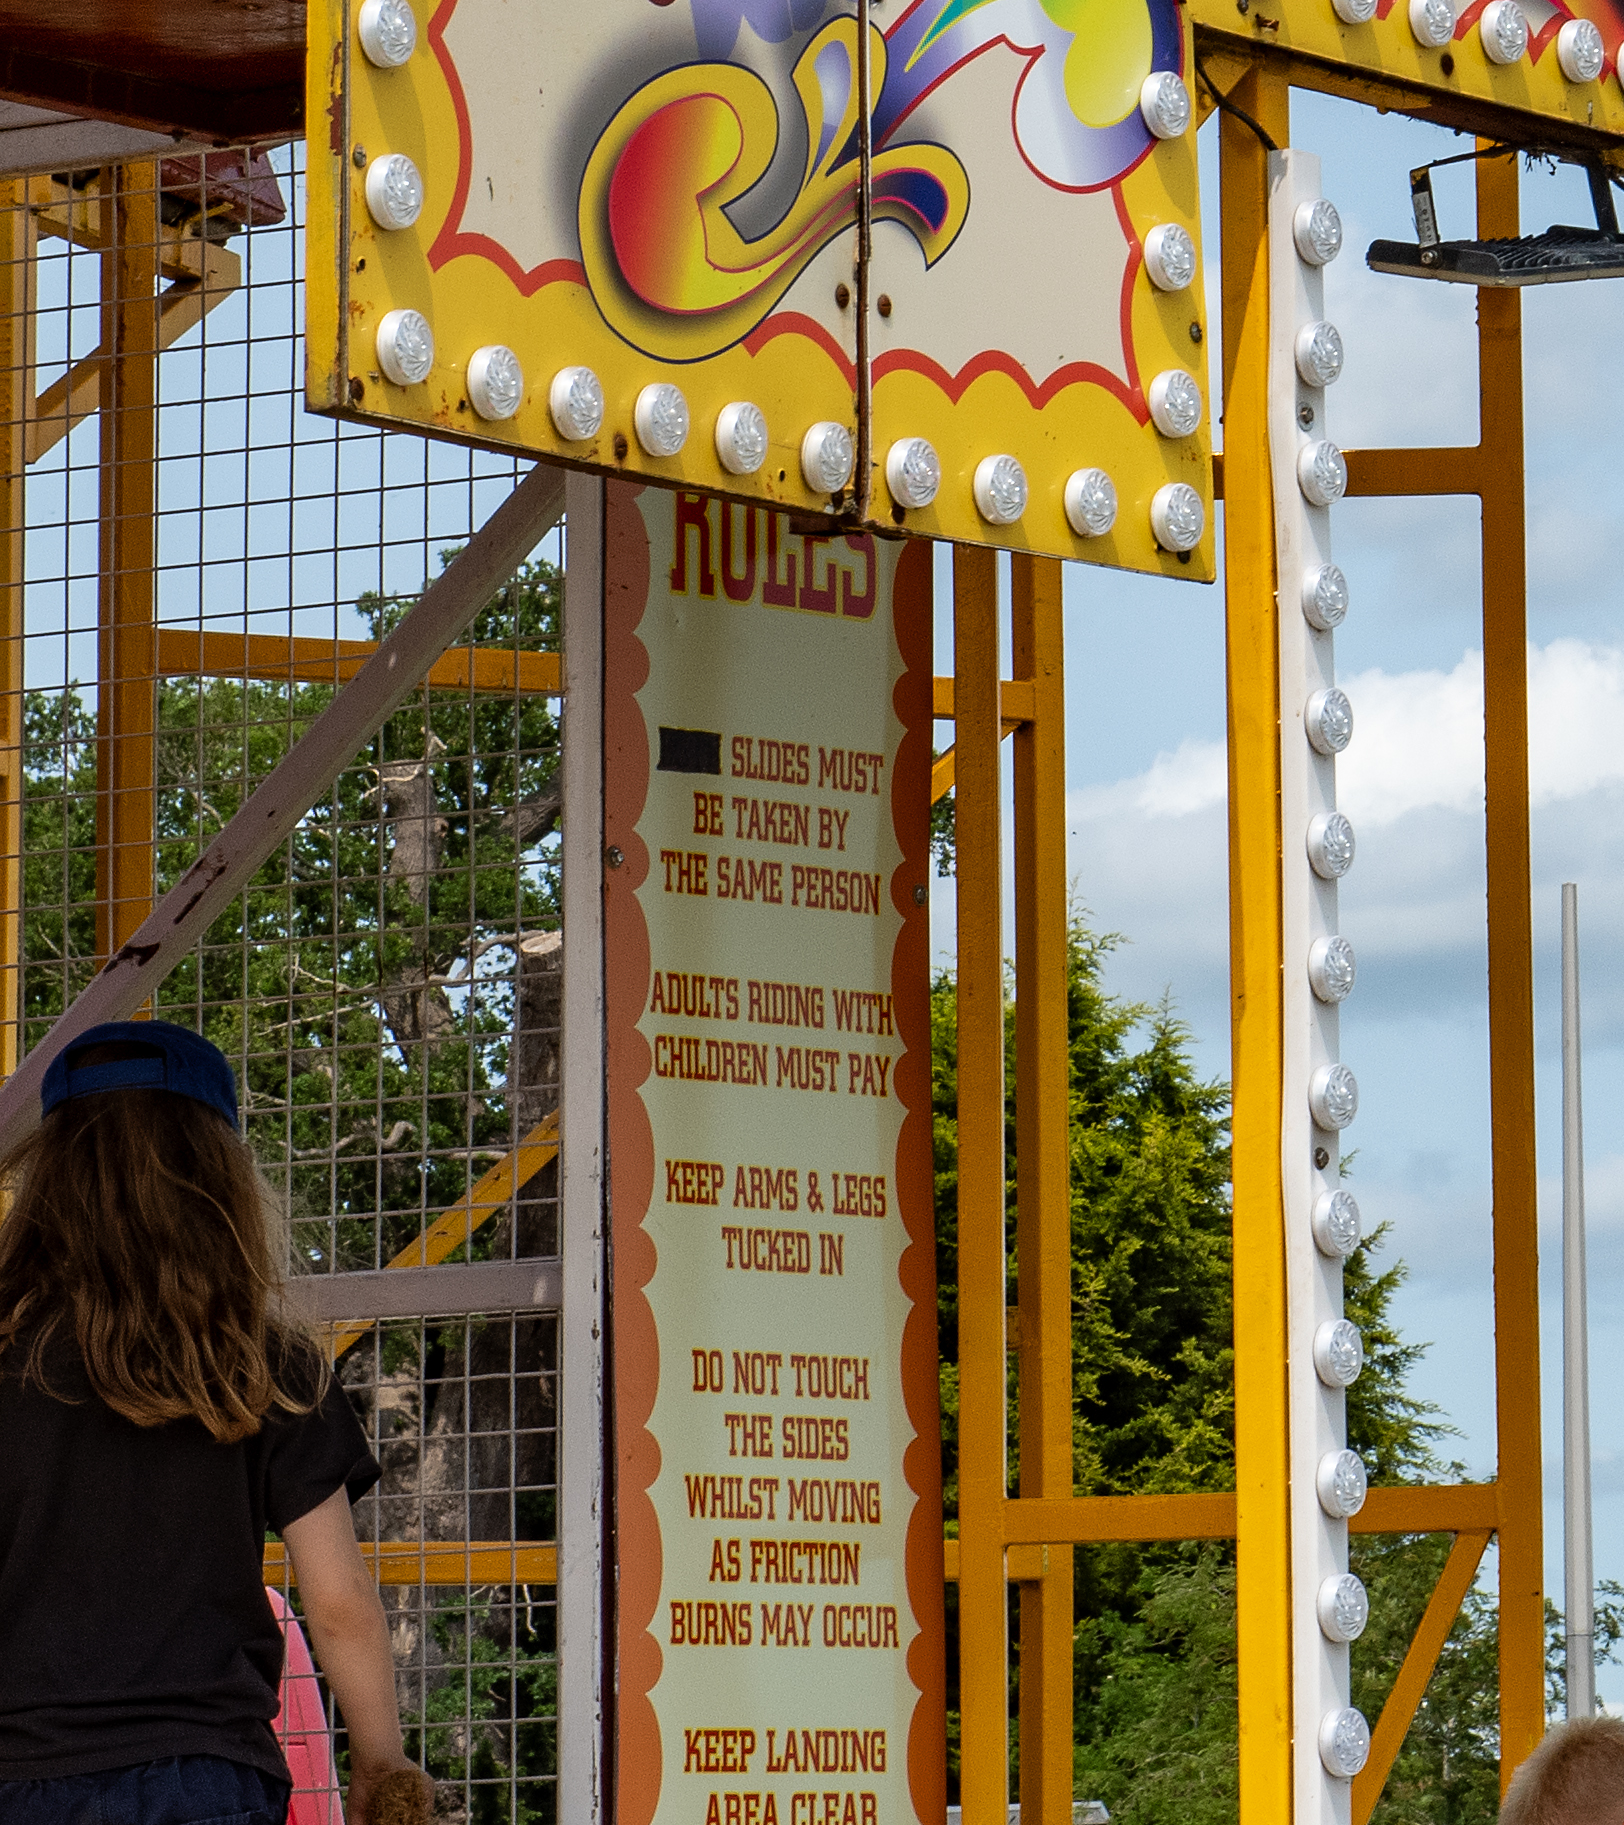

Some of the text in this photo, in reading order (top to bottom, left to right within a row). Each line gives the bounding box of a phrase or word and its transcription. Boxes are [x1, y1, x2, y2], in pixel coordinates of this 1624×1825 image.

[669, 490, 878, 622] RULES
[730, 734, 886, 797] SLIDES MUST
[691, 790, 851, 852] BE TAKEN BY
[658, 848, 883, 917] THE SAME PERSON
[650, 971, 894, 1037] ADULTS RIDING WITH
[653, 1033, 893, 1099] CHILDREN MUST PAY
[663, 1158, 888, 1219] KEEP ARMS & LEGS
[720, 1225, 845, 1277] TUCKED IN
[690, 1348, 871, 1401] DO NOT TOUCH
[723, 1412, 850, 1462] THE SIDES
[683, 1474, 882, 1525] WHILST MOVING
[708, 1538, 861, 1587] AS FRICTION
[669, 1600, 900, 1649] BURNS MAY OCCUR
[683, 1728, 887, 1774] KEEP LANDING
[704, 1791, 878, 1825] AREA CLEAR
